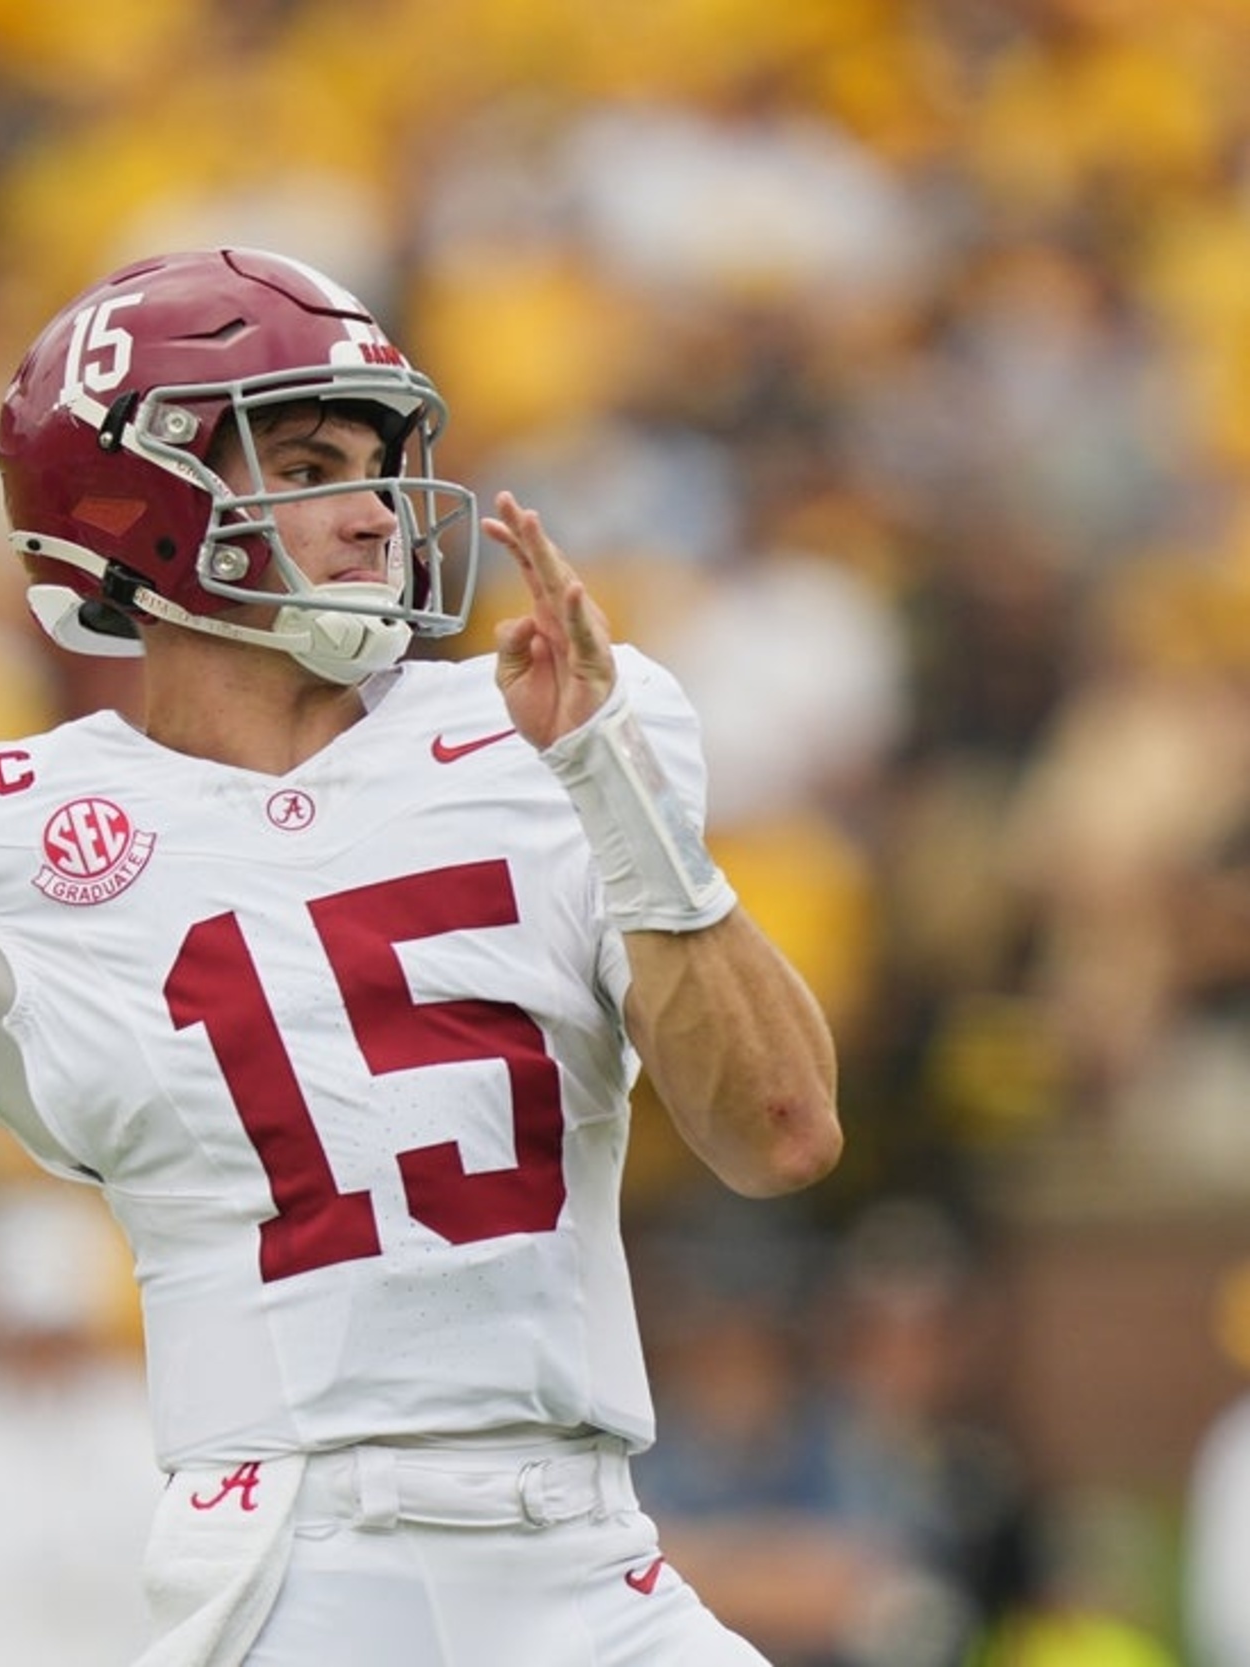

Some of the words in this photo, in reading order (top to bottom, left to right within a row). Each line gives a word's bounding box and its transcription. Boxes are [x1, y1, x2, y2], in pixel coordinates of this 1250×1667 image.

[58, 292, 144, 405] 15
[47, 800, 128, 875] SEC
[52, 851, 144, 902] GRADUATE
[163, 858, 567, 1284] 15
[190, 1460, 261, 1511] A
